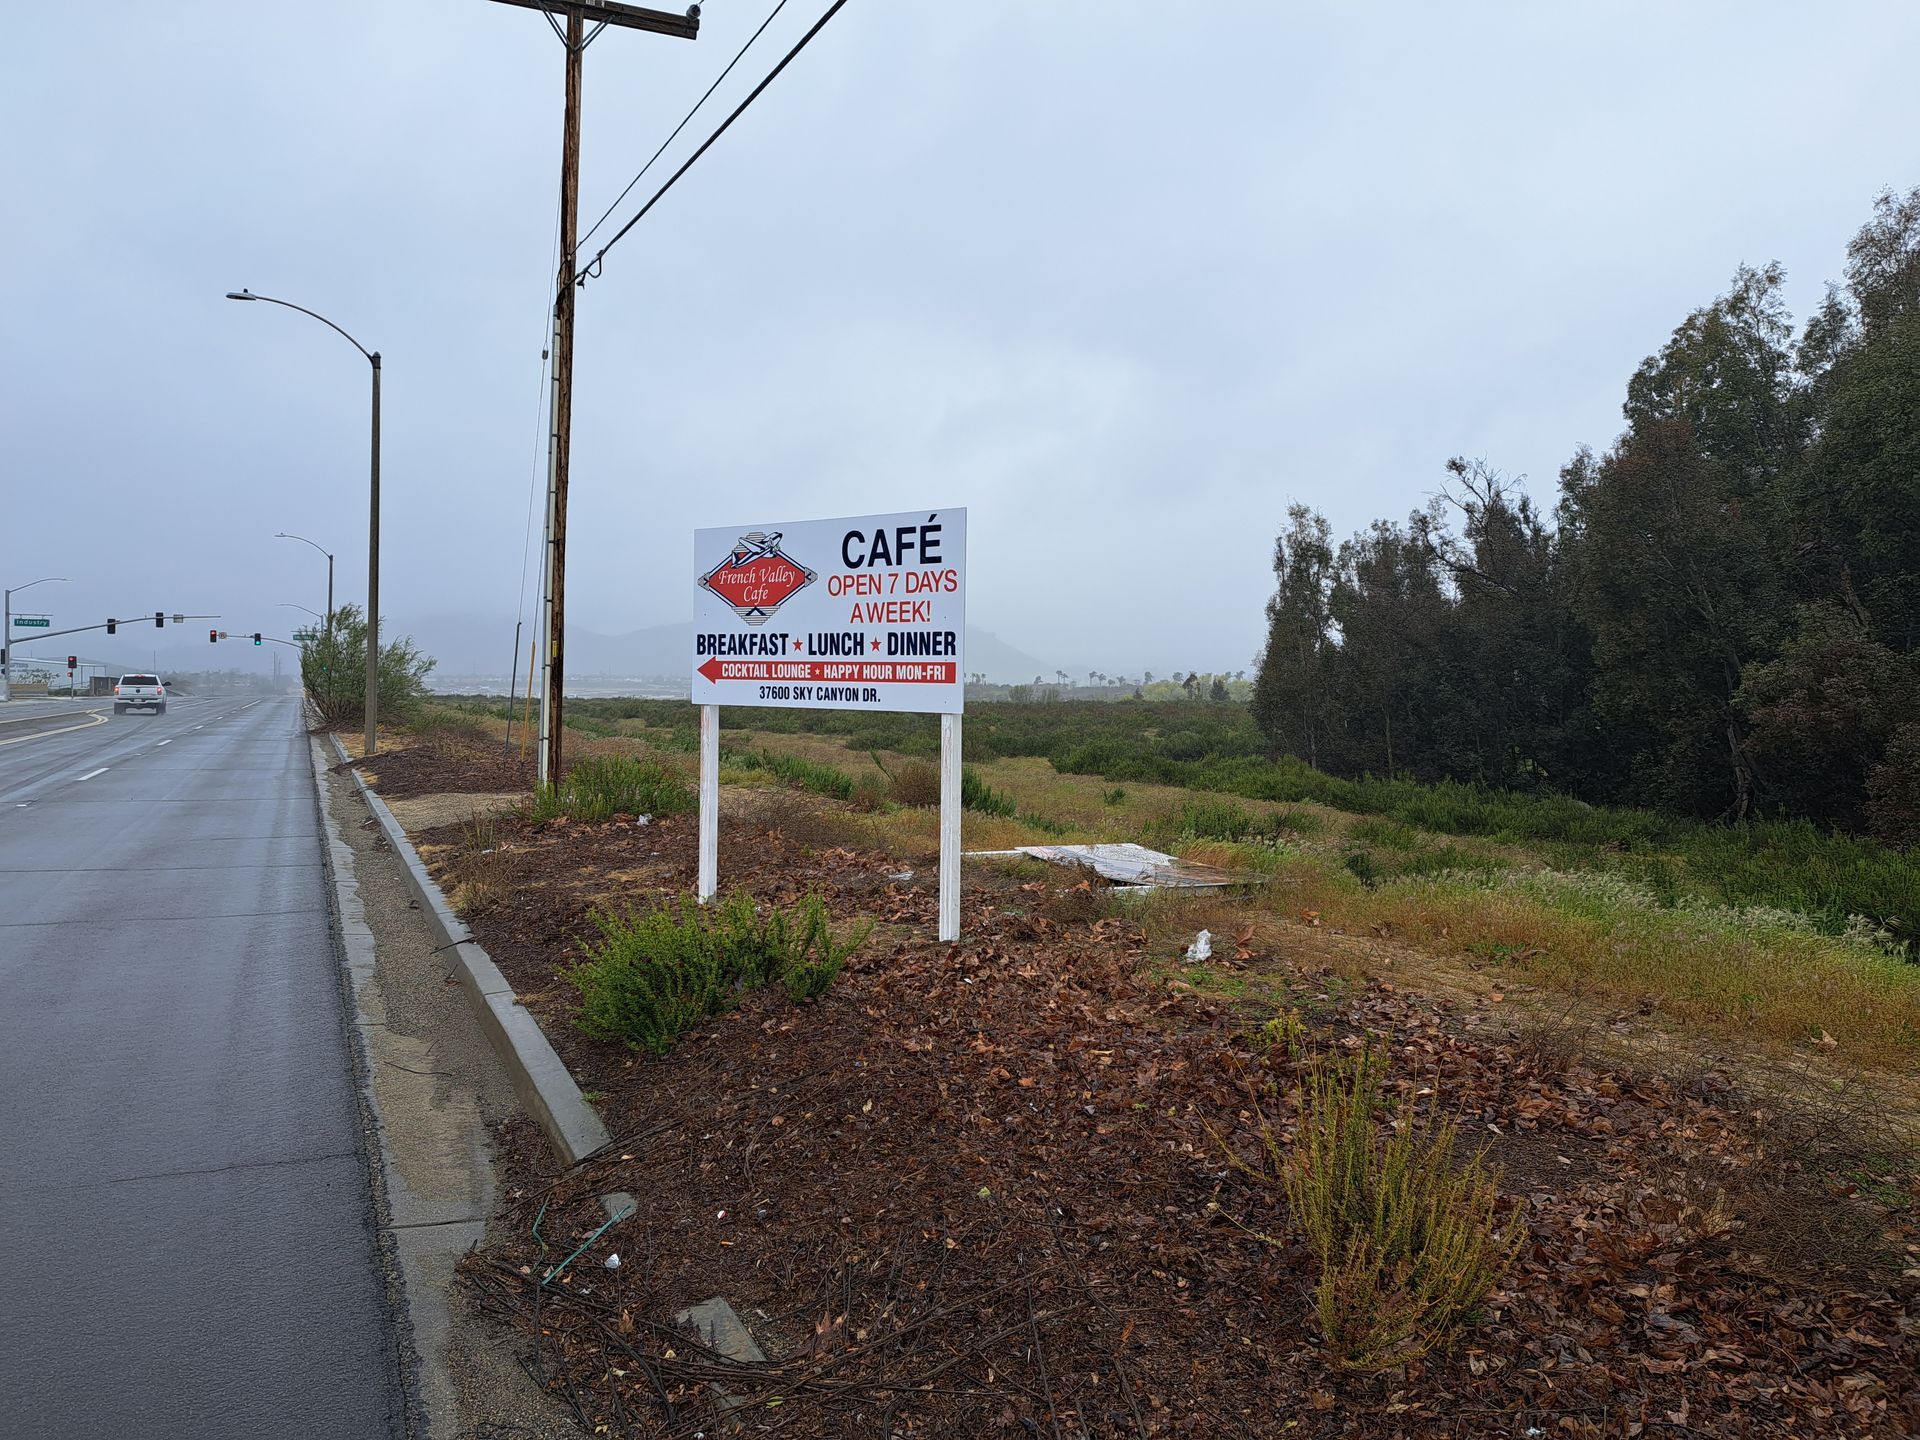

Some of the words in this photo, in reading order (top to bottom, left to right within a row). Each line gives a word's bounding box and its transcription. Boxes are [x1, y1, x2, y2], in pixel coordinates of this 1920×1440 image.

[842, 513, 942, 569] CAFÉ
[719, 567, 756, 585] French
[759, 565, 795, 587] Valley
[828, 573, 882, 596] OPEN
[888, 573, 899, 594] 7
[905, 569, 958, 593] DAYS
[743, 583, 768, 605] Cafe
[866, 600, 931, 623] WEEK!
[696, 633, 789, 655] BREAKFAST
[808, 632, 864, 656] LUNCH
[887, 631, 956, 656] DINNER
[722, 663, 769, 678] COCKTAIL
[772, 664, 811, 679] LOUNGE
[823, 664, 859, 679] HAPPY
[863, 665, 893, 680] HOUR
[896, 665, 945, 680] MON-FRI
[759, 686, 790, 700] 37600
[793, 686, 813, 701] SKY
[816, 686, 859, 702] CANYON
[862, 688, 881, 702] DR.
